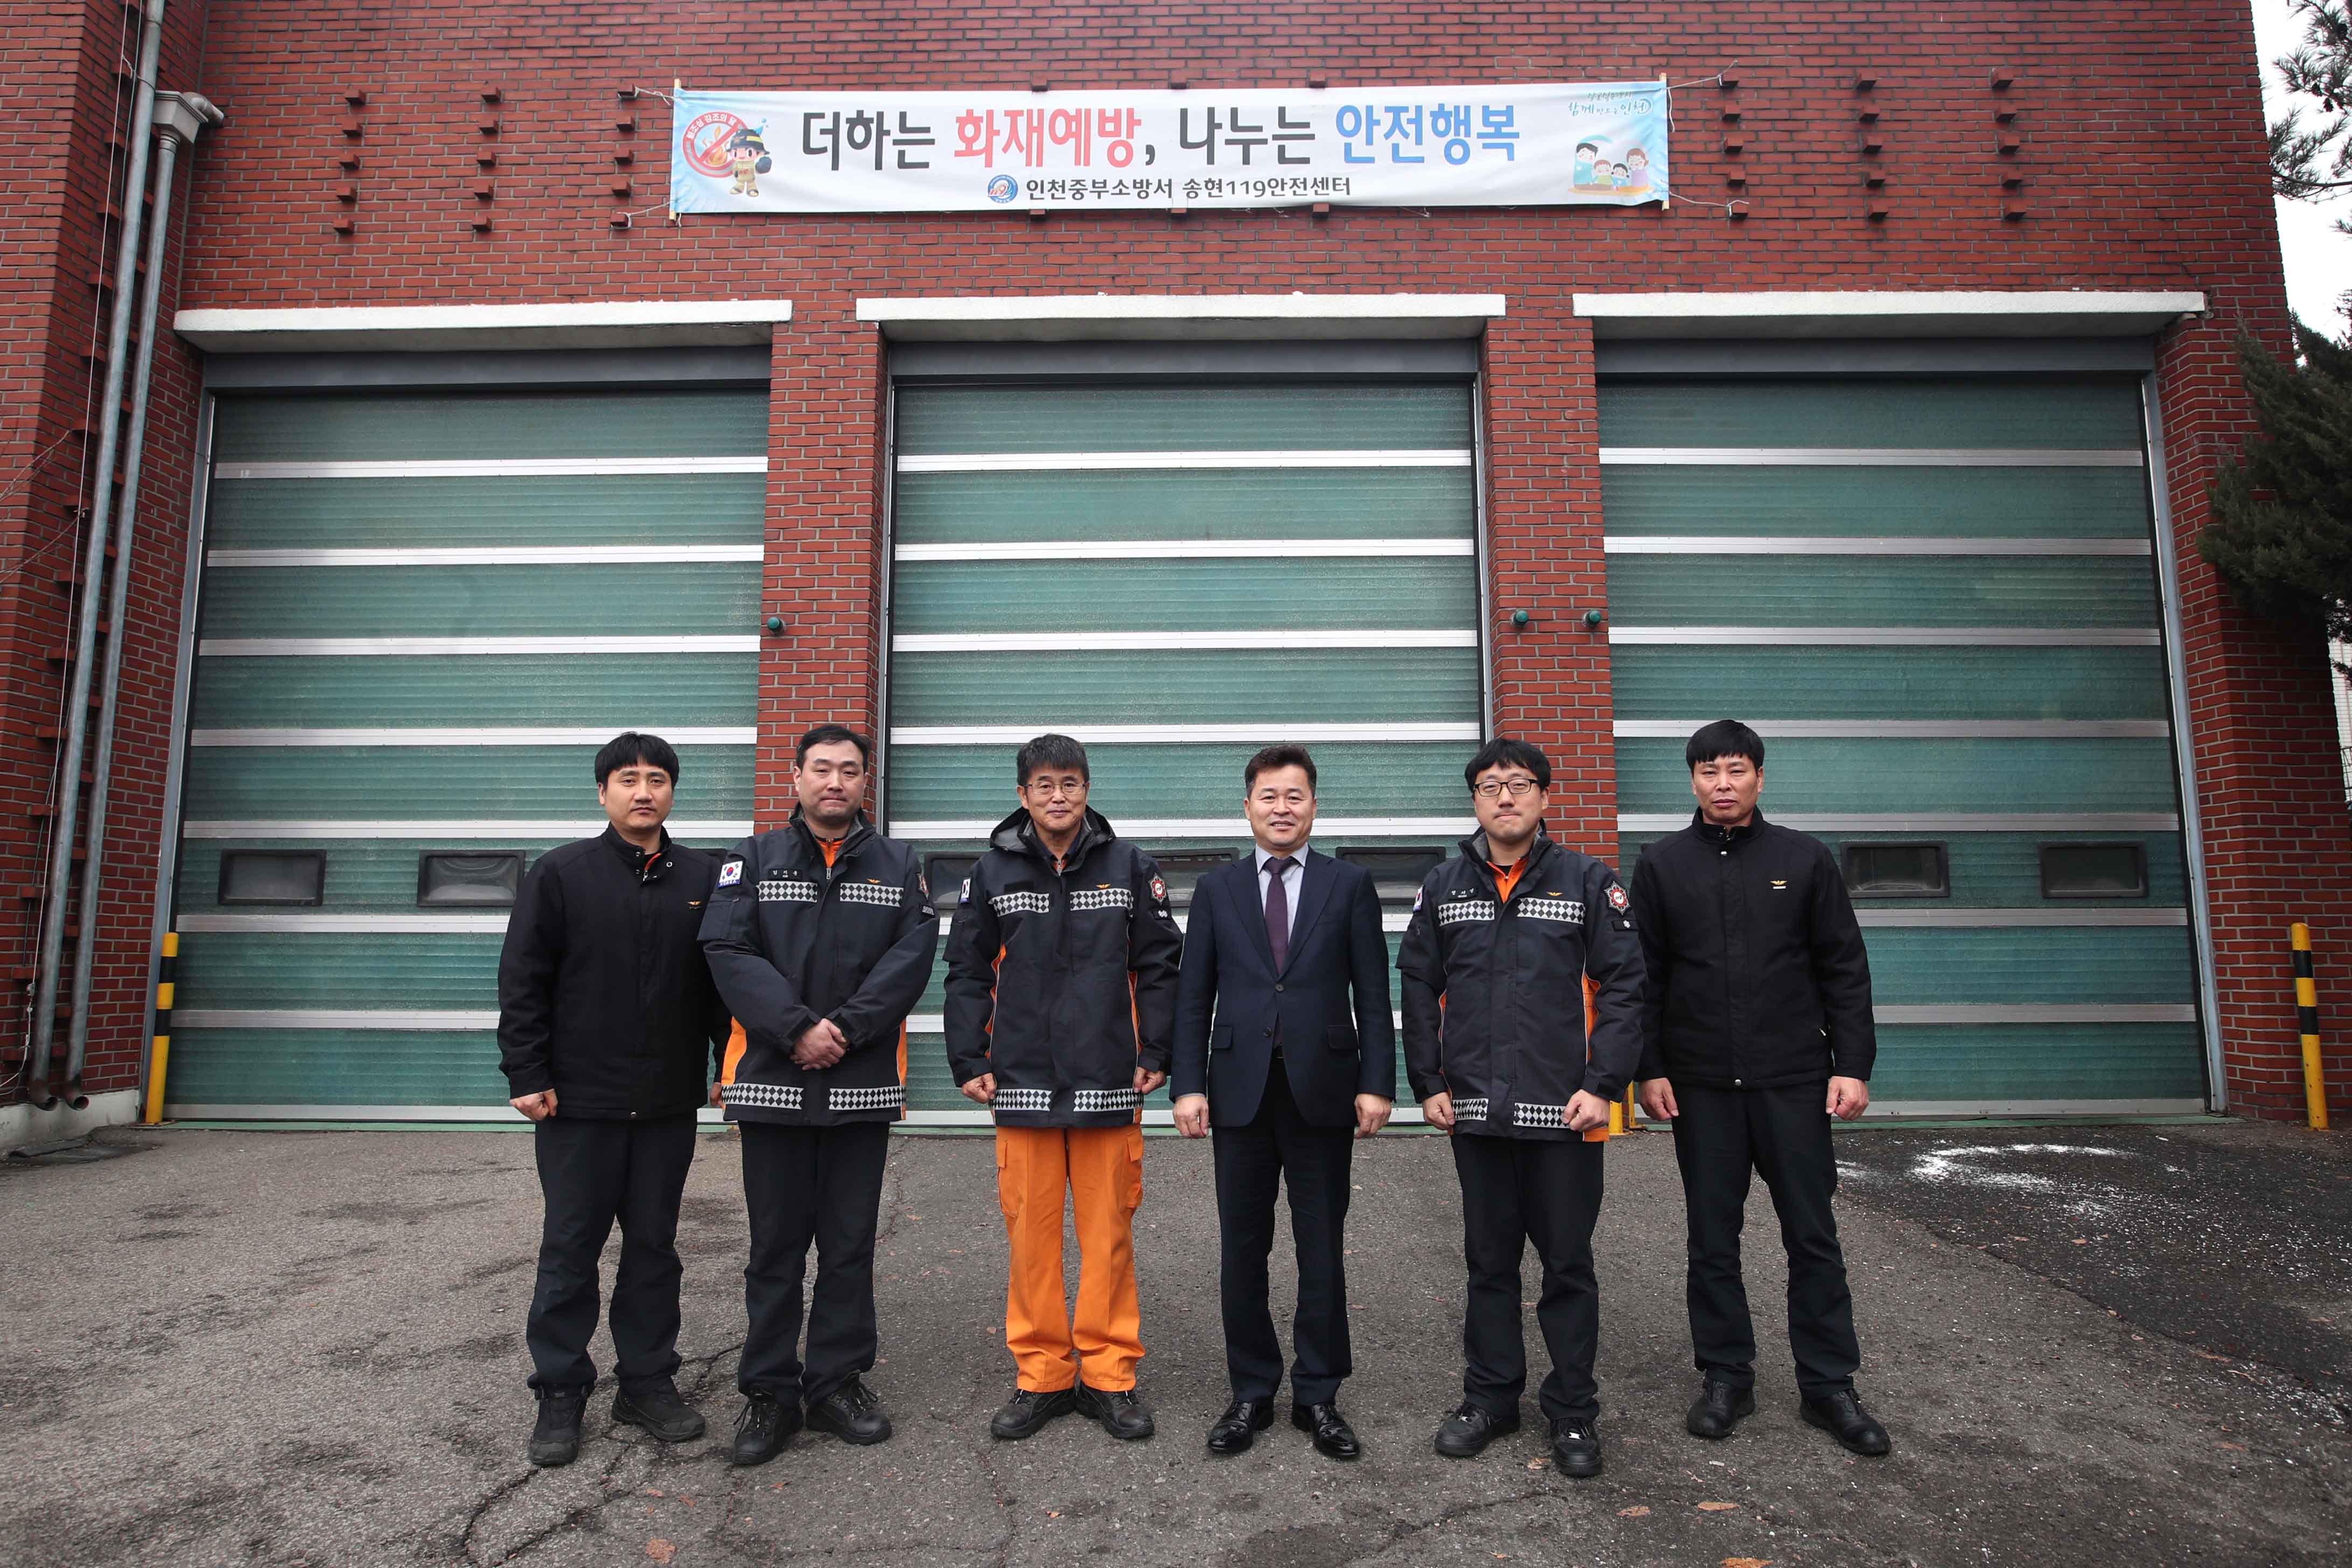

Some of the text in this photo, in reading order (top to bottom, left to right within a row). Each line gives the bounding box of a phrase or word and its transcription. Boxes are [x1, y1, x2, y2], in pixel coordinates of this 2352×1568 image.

[704, 113, 728, 123] 강조의
[1568, 101, 1594, 116] 함께
[802, 103, 1520, 171] 더하는 화재예방, 나누는 안전행복
[1026, 178, 1172, 200] 인천중부소방서
[1182, 177, 1351, 198] 송현119안전센터
